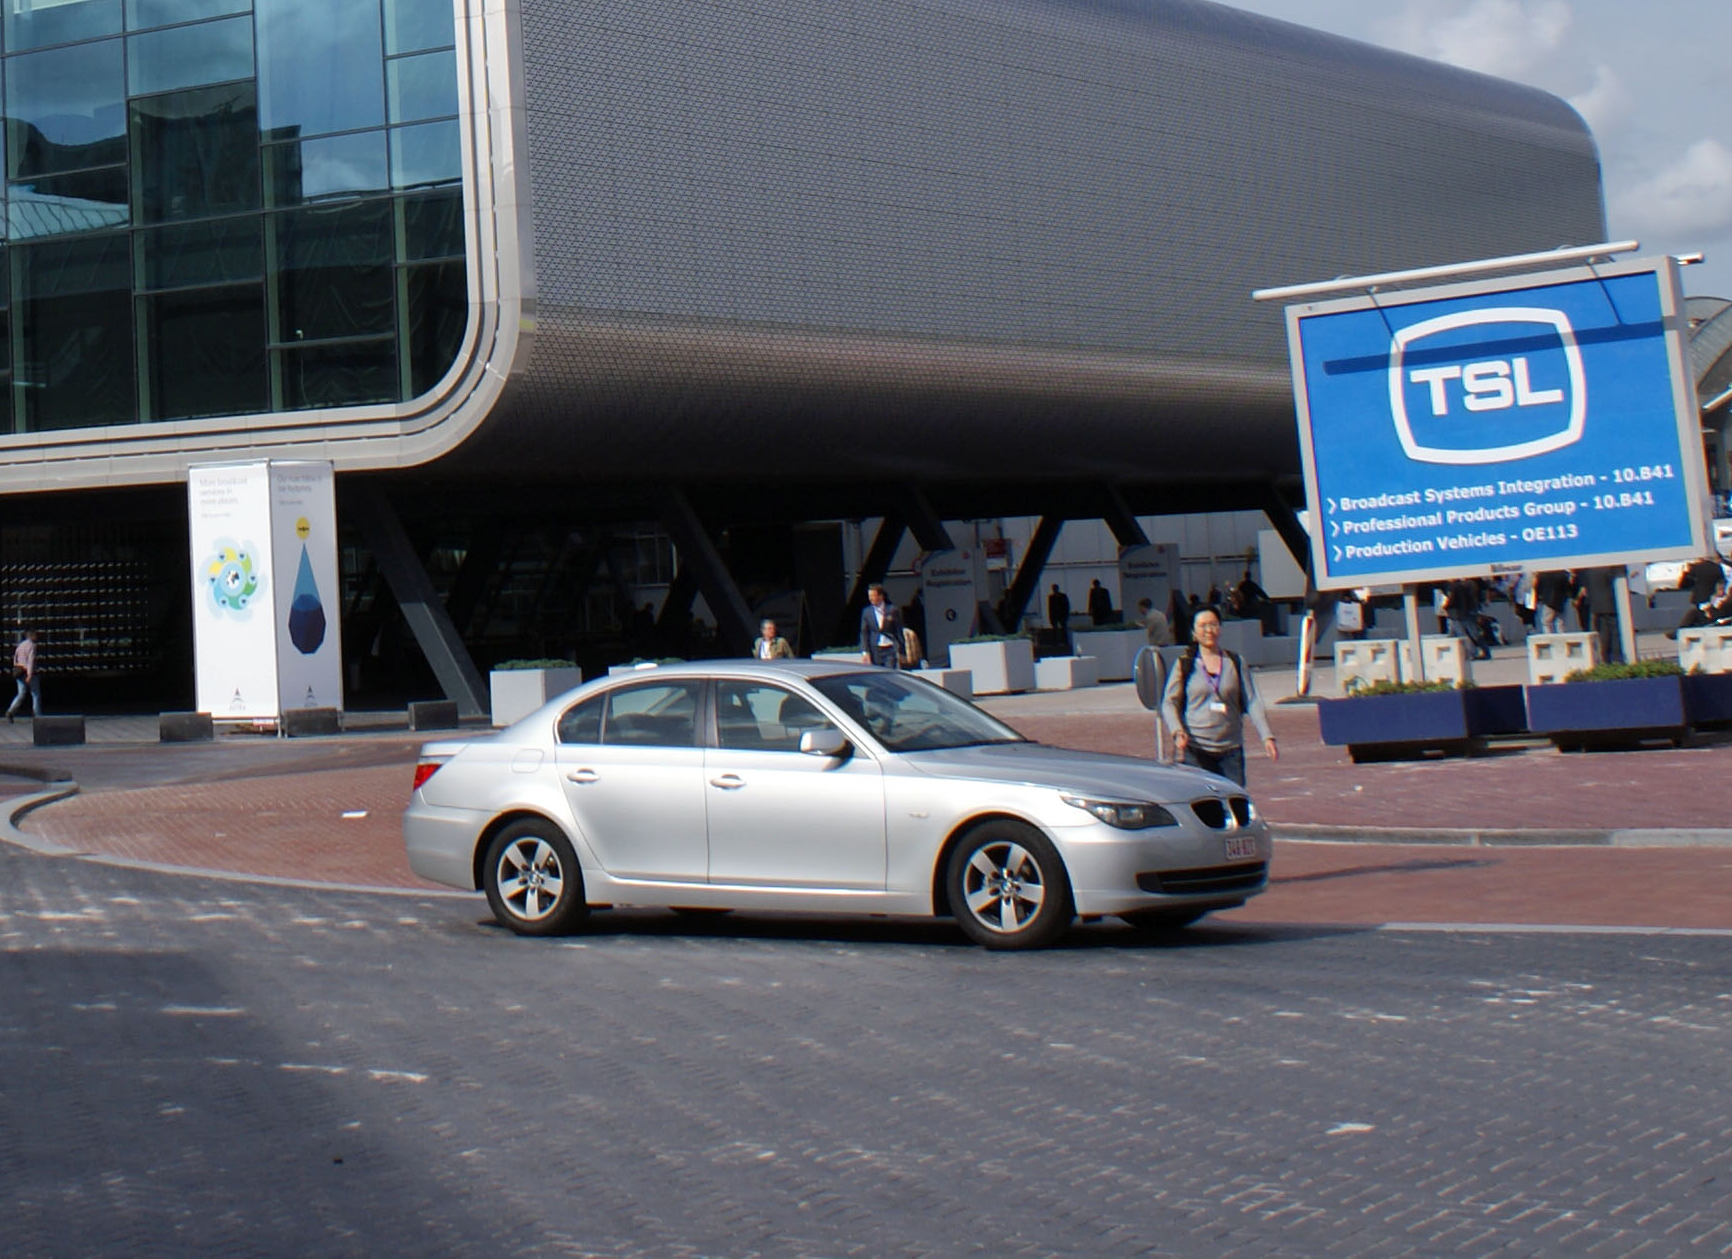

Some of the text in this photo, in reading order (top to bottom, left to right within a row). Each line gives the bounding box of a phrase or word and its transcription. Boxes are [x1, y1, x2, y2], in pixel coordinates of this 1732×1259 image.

[1409, 356, 1565, 417] TSL
[1340, 491, 1421, 511] Broadcast
[1425, 483, 1495, 504] Systems
[1498, 473, 1596, 495] Integration
[1612, 464, 1674, 483] 10.B41
[1342, 512, 1443, 534] Professional
[1446, 505, 1521, 525] Products
[1523, 500, 1577, 517] Group
[1593, 491, 1655, 510] 10.B41
[1345, 539, 1434, 558] Production
[1436, 531, 1507, 551] Vehicles
